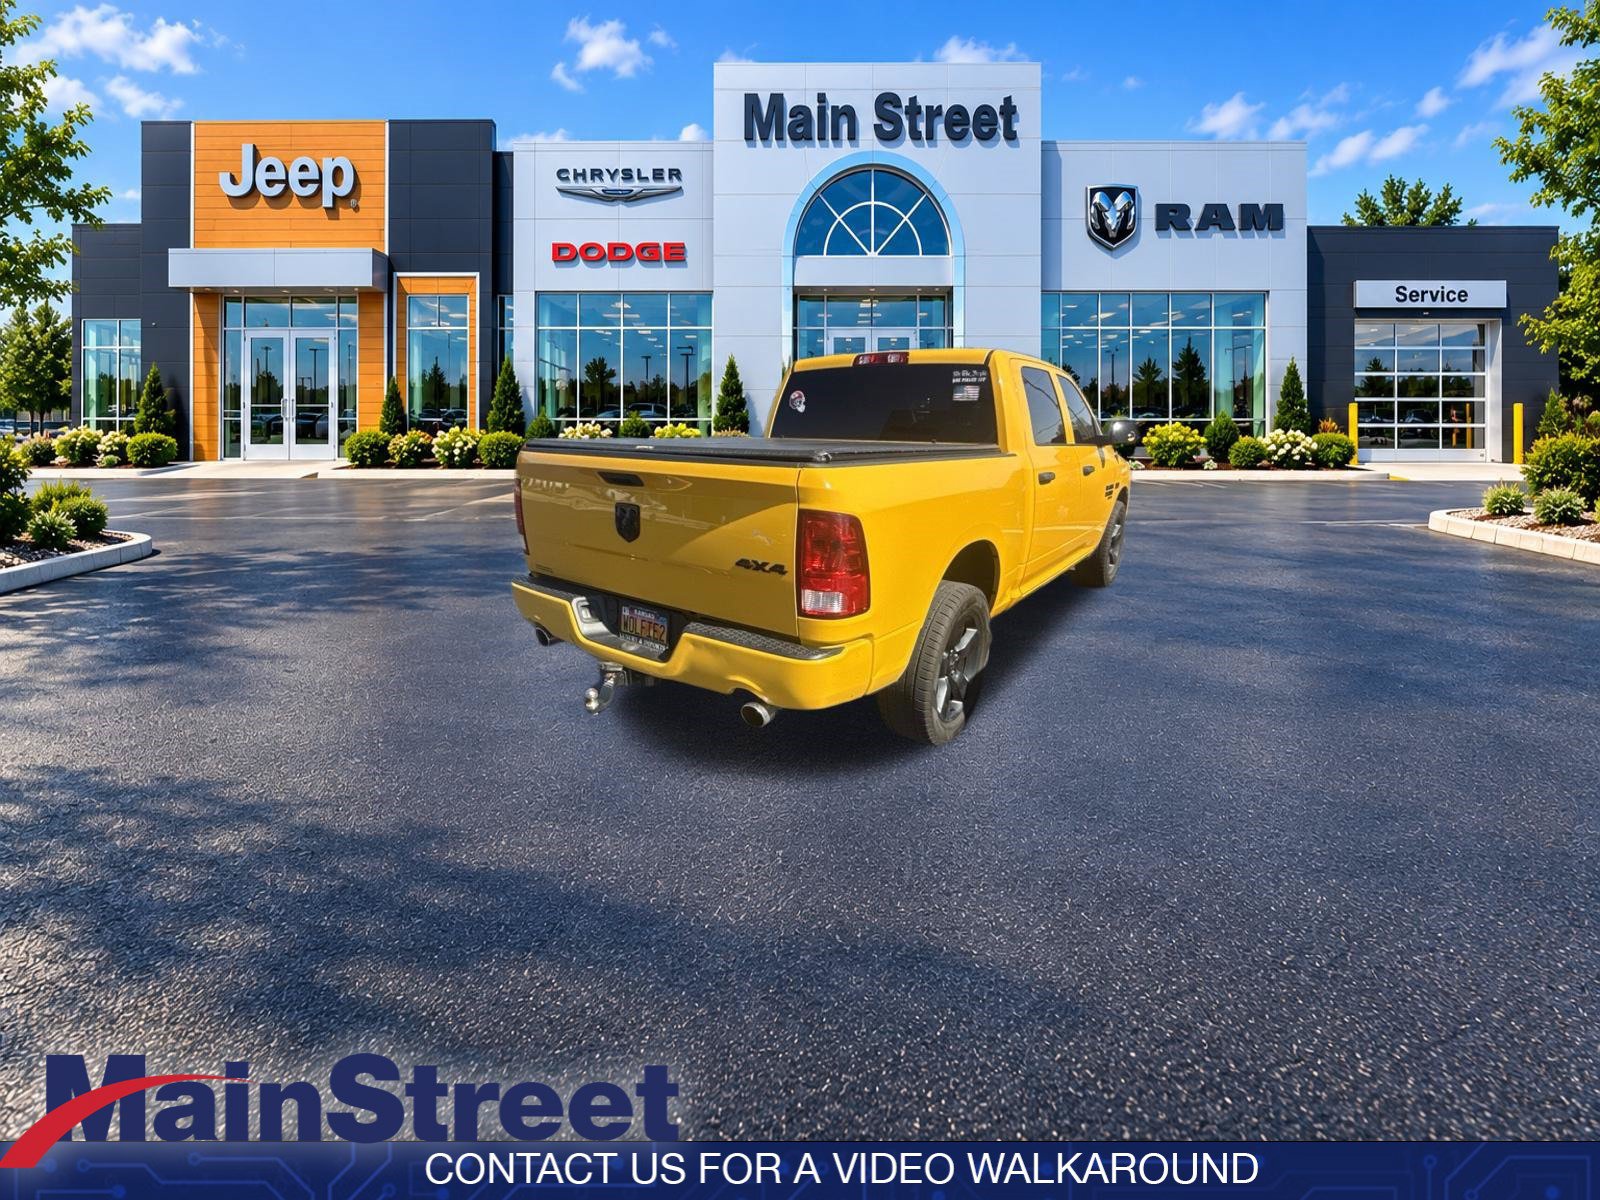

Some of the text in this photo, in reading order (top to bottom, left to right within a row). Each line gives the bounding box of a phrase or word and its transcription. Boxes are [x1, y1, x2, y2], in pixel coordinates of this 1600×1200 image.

[745, 92, 1018, 142] Main Street
[219, 143, 355, 210] Jeep
[556, 168, 682, 182] CHRYSLER
[1155, 203, 1284, 231] RAM
[551, 242, 685, 262] DODGE
[1395, 285, 1469, 303] Service
